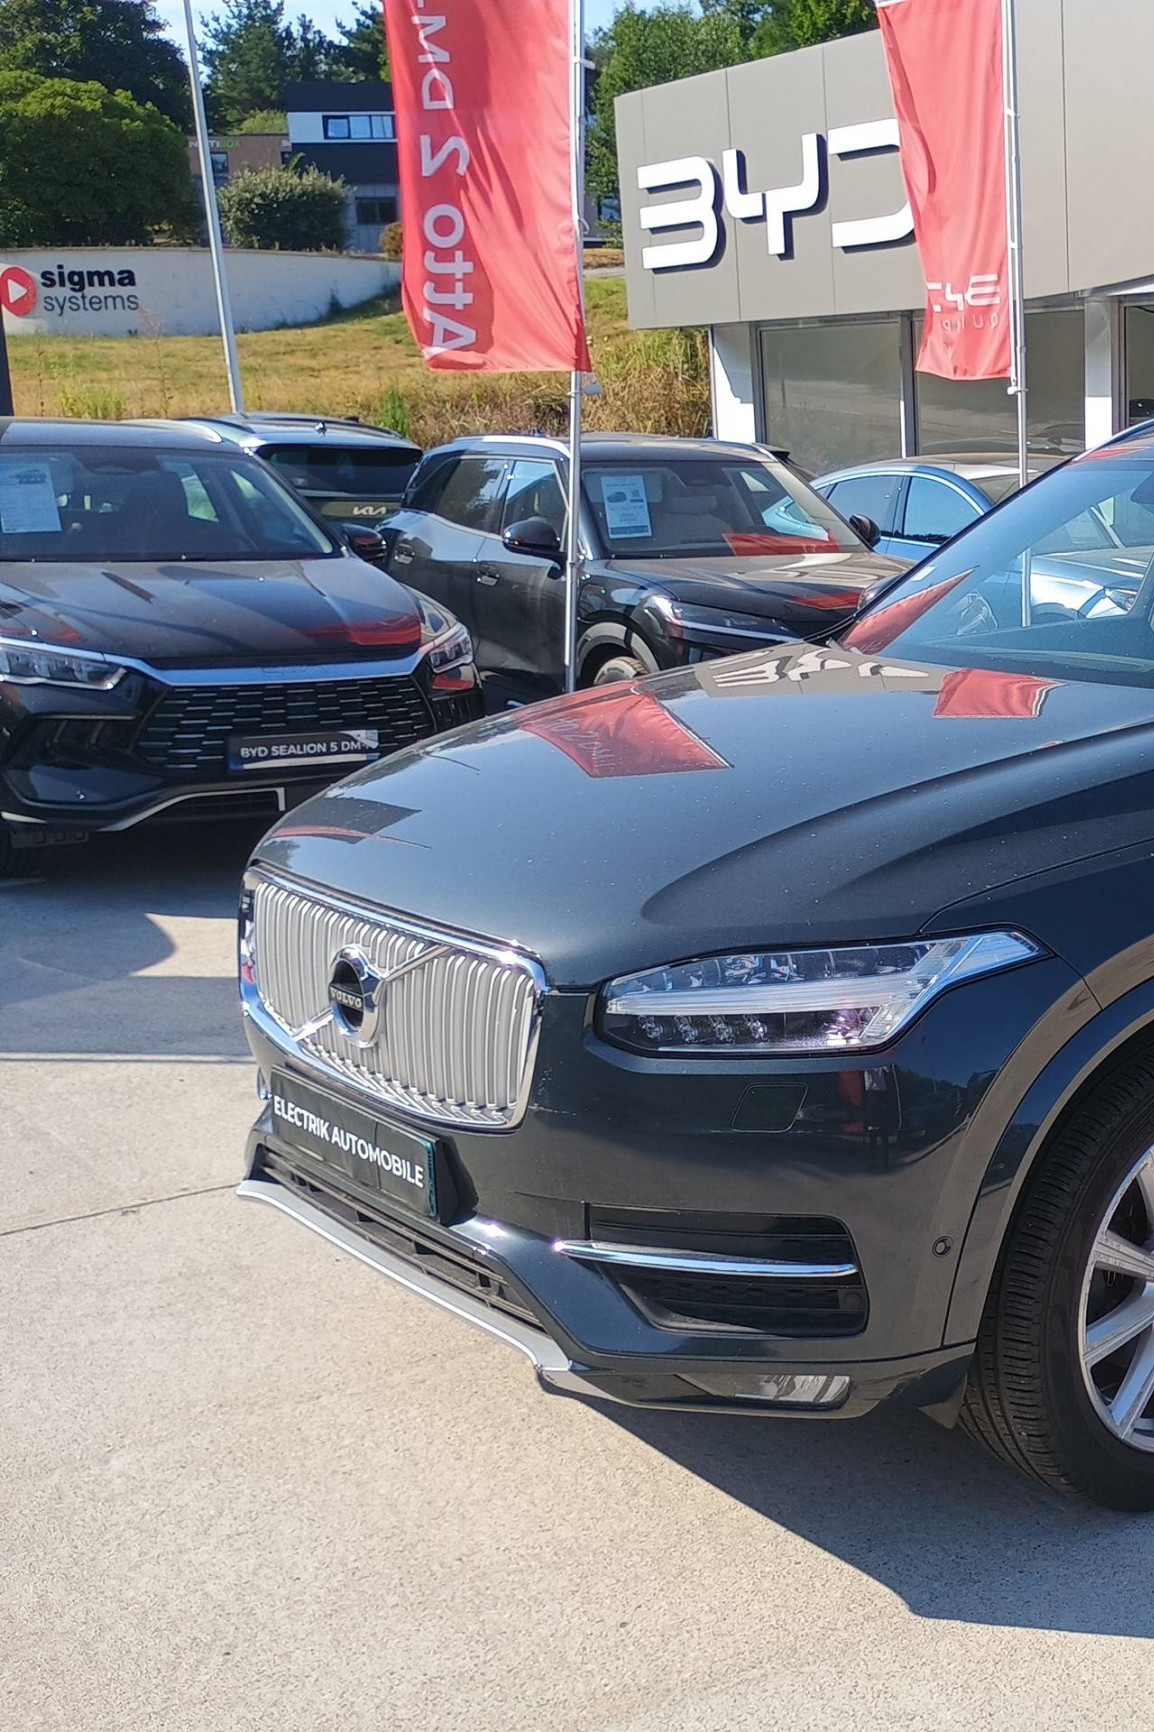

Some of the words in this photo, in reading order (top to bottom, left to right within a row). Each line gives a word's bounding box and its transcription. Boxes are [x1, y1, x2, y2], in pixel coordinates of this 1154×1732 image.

[637, 117, 915, 270] BYD
[40, 264, 136, 292] sigma
[43, 291, 139, 317] systems
[240, 747, 268, 758] BYD
[271, 743, 327, 756] SEALION
[330, 741, 338, 752] 5
[330, 987, 362, 1008] VOLVO
[274, 1095, 330, 1142] ELECTRIK
[331, 1126, 424, 1188] AUTOMOBILE
